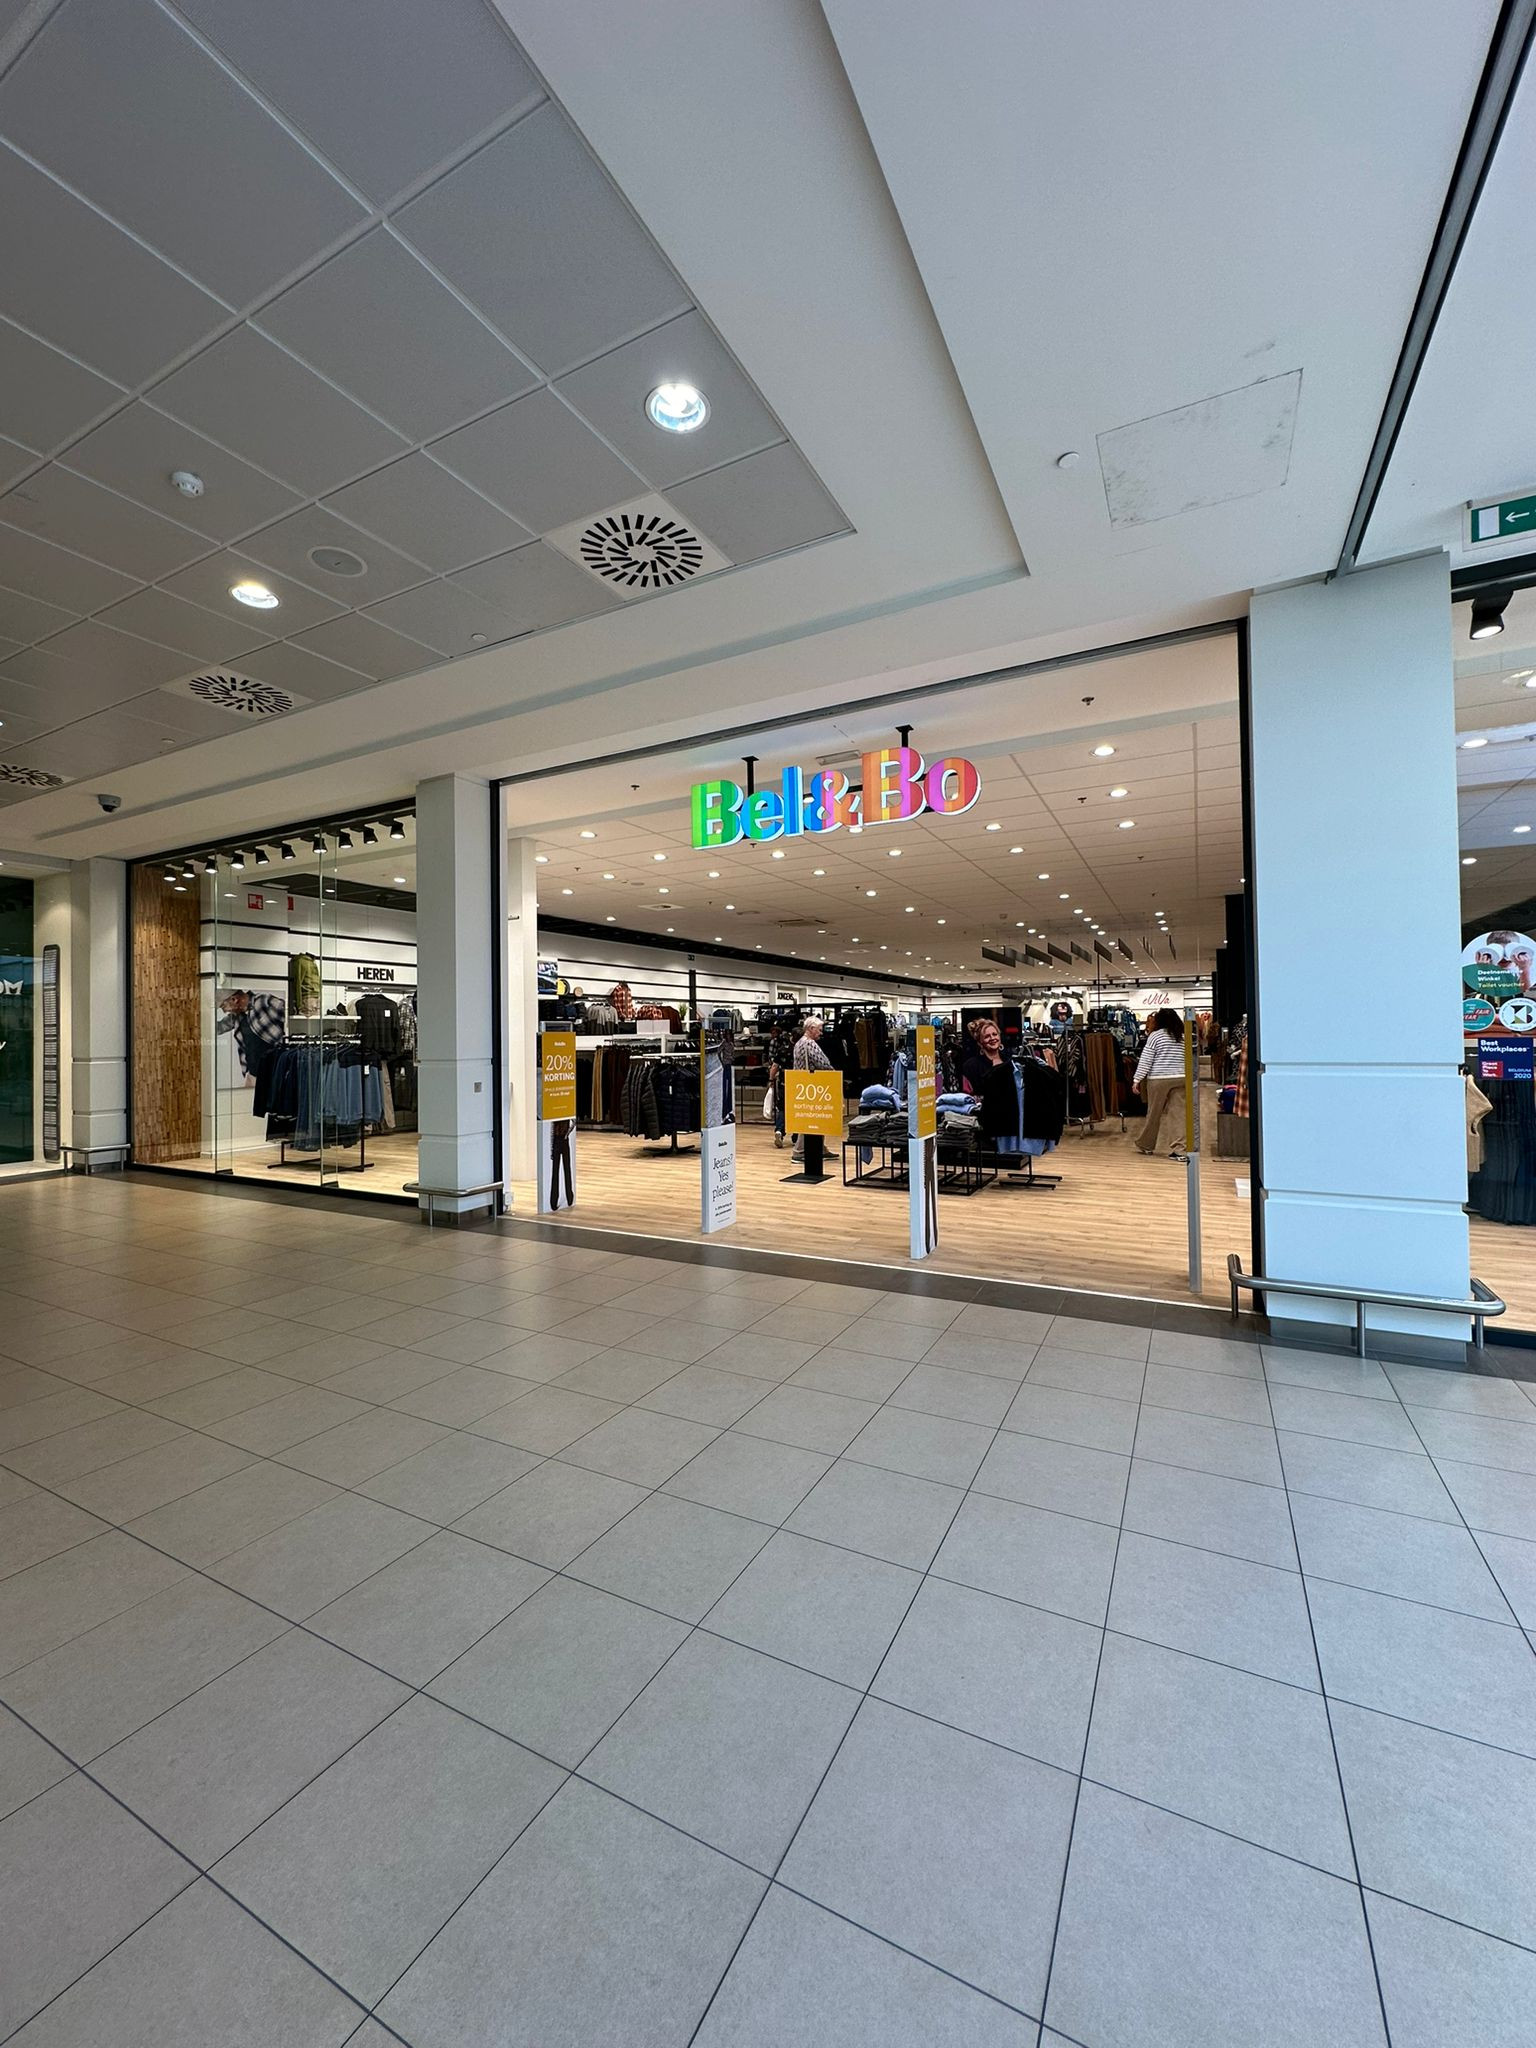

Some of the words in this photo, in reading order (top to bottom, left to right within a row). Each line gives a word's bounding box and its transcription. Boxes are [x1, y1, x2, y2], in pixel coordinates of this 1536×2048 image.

[691, 747, 982, 849] Bel&Bo
[357, 966, 394, 981] HEREN
[546, 1054, 574, 1071] 20%
[919, 1055, 934, 1075] 20%
[544, 1072, 575, 1082] KORTING
[795, 1083, 832, 1102] 20%
[713, 1153, 733, 1170] Jeans?
[718, 1170, 729, 1182] Yes
[712, 1181, 734, 1202] please!
